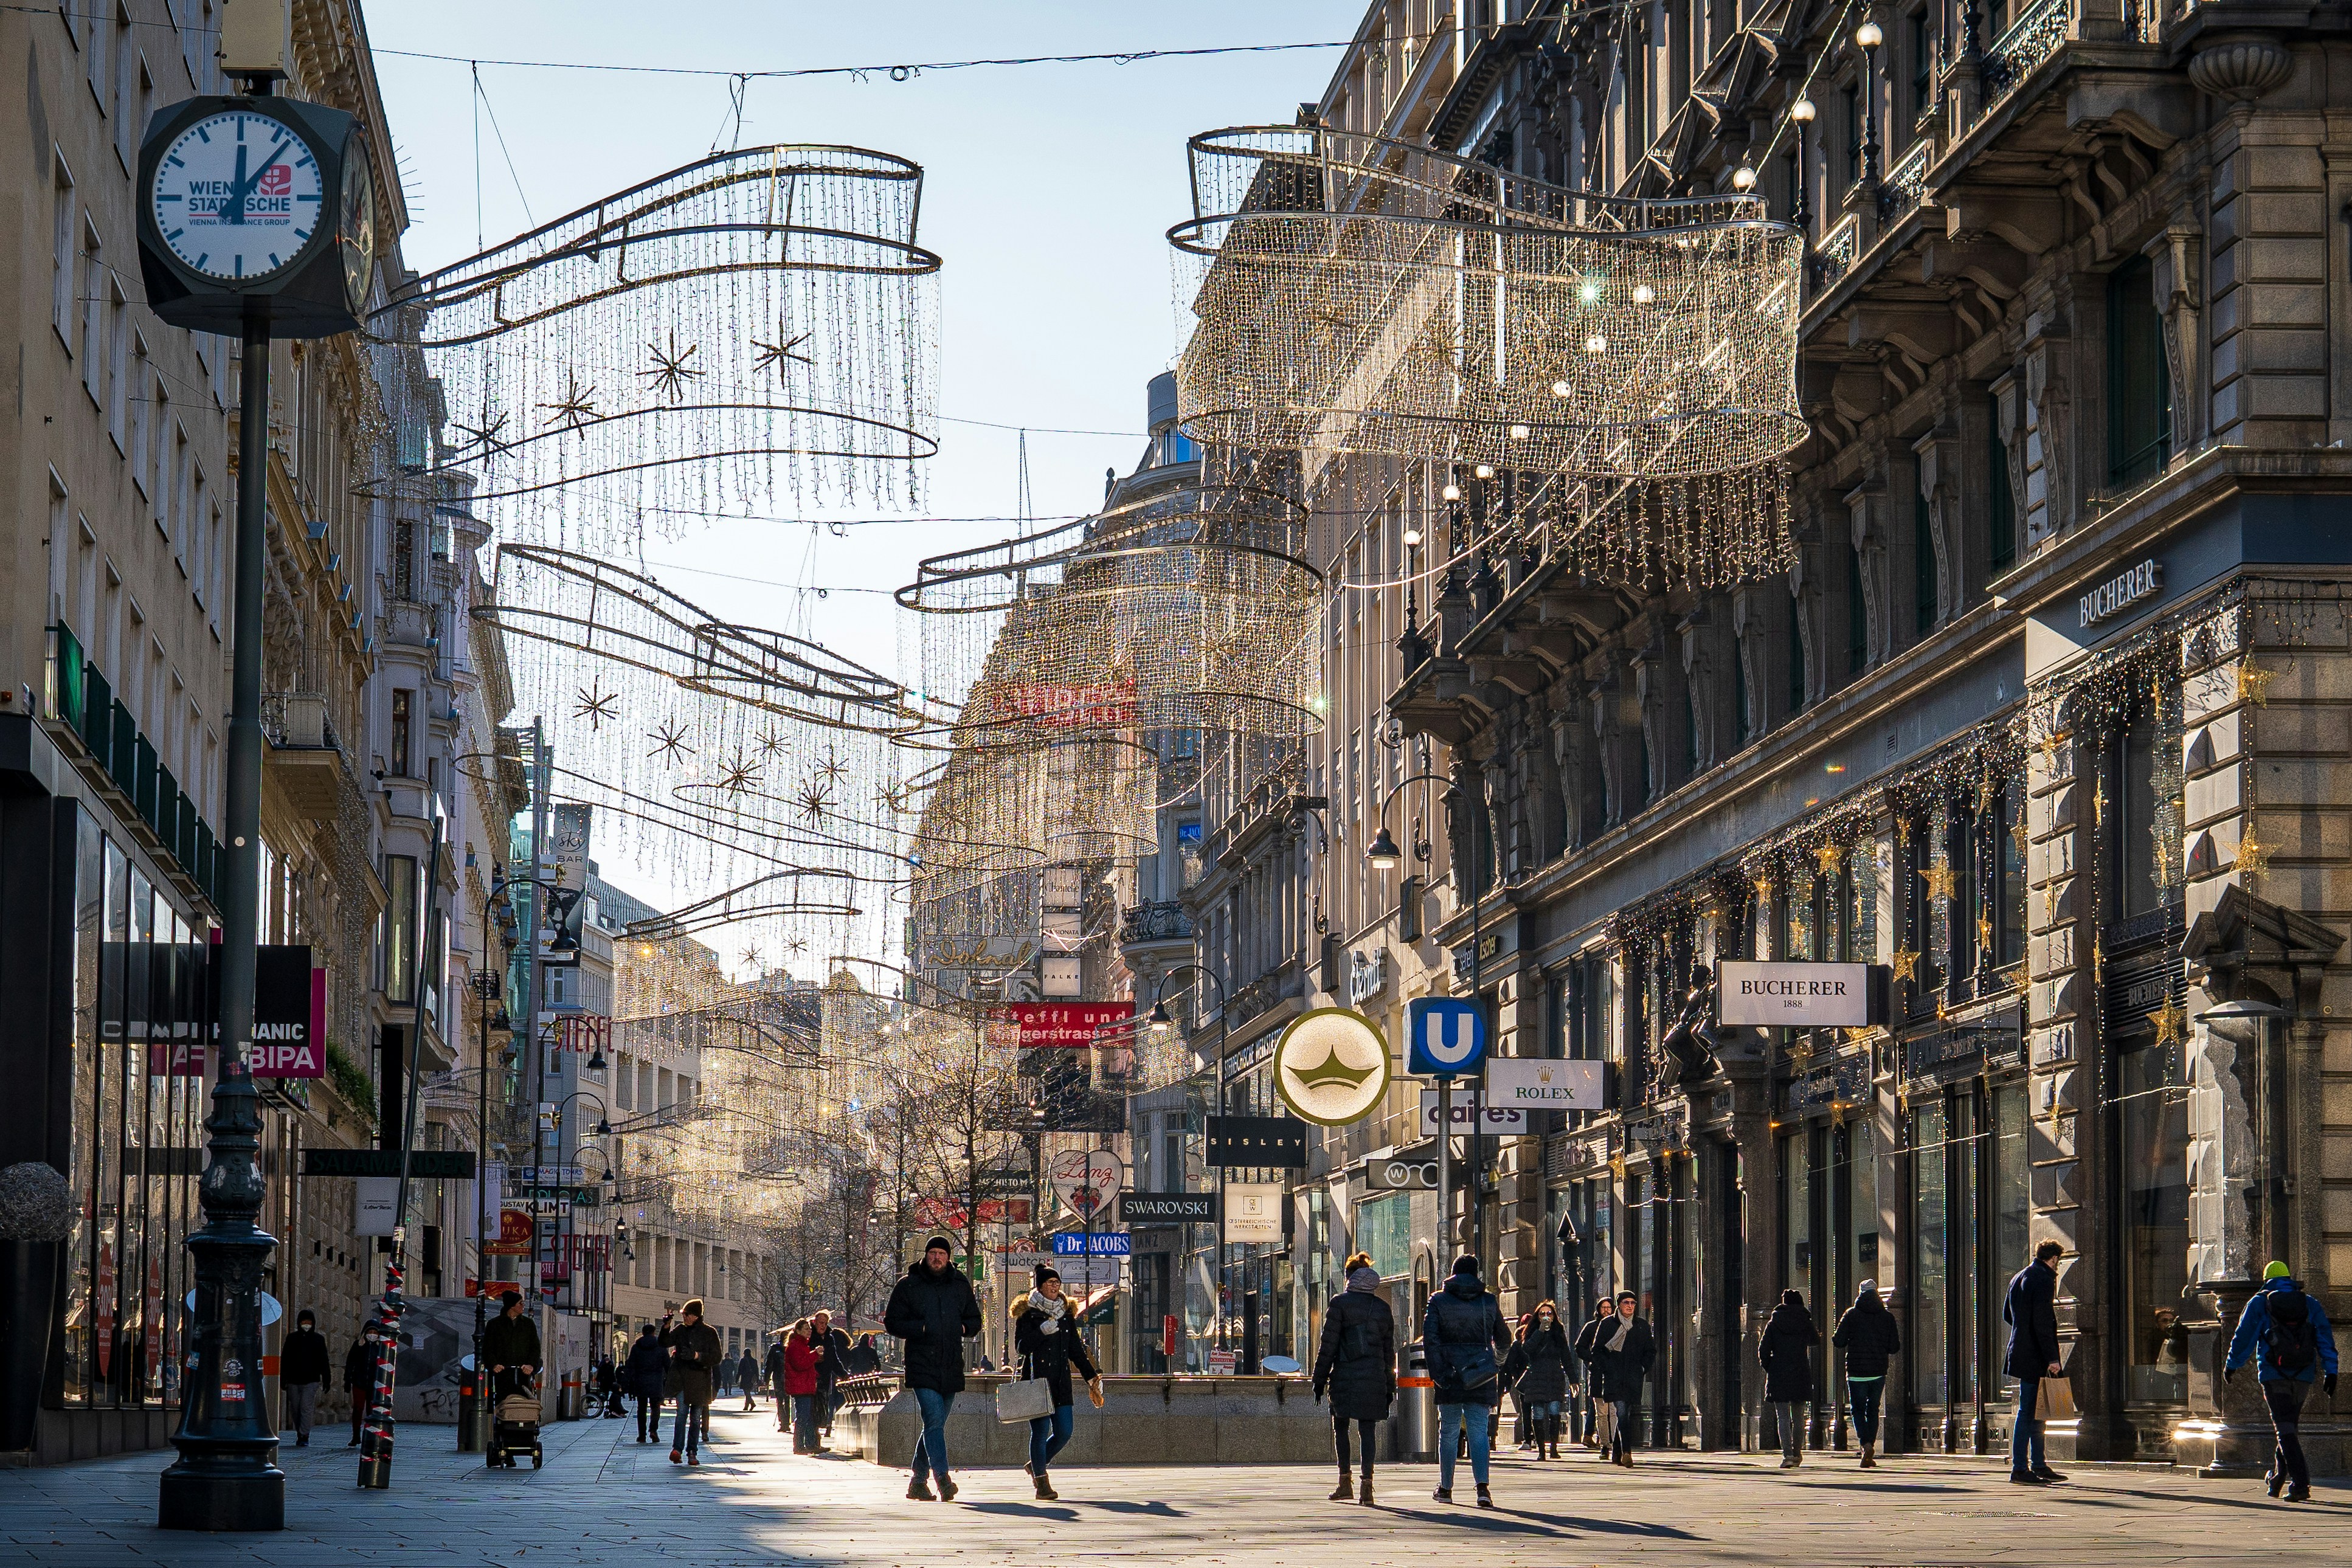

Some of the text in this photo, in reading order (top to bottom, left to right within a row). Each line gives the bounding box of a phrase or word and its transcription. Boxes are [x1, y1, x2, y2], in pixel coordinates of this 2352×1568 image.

[189, 181, 257, 195] WIENR
[189, 198, 291, 211] STÄDSCHE
[2079, 559, 2156, 628] BUCHERER
[557, 854, 583, 863] BAR
[1740, 980, 1847, 996] BUCHERER
[2128, 978, 2176, 1007] BUCHERR
[1783, 1000, 1802, 1008] 1888
[1011, 1010, 1126, 1023] teffl und
[1021, 1027, 1111, 1043] gerstrasse
[1427, 1012, 1474, 1063] U
[250, 1046, 316, 1069] BIPA
[1515, 1086, 1575, 1100] ROLEX
[1210, 1138, 1301, 1147] SISLEY
[313, 1153, 467, 1174] SALAMANDER
[1057, 1155, 1115, 1188] Lanz
[525, 1201, 569, 1214] KLIMT
[1125, 1201, 1208, 1215] SWAROVSKI
[502, 1226, 528, 1237] UKA
[1067, 1235, 1130, 1252] Dr JACOBS
[541, 1262, 562, 1274] STEFL
[1001, 1255, 1046, 1267] swatch
